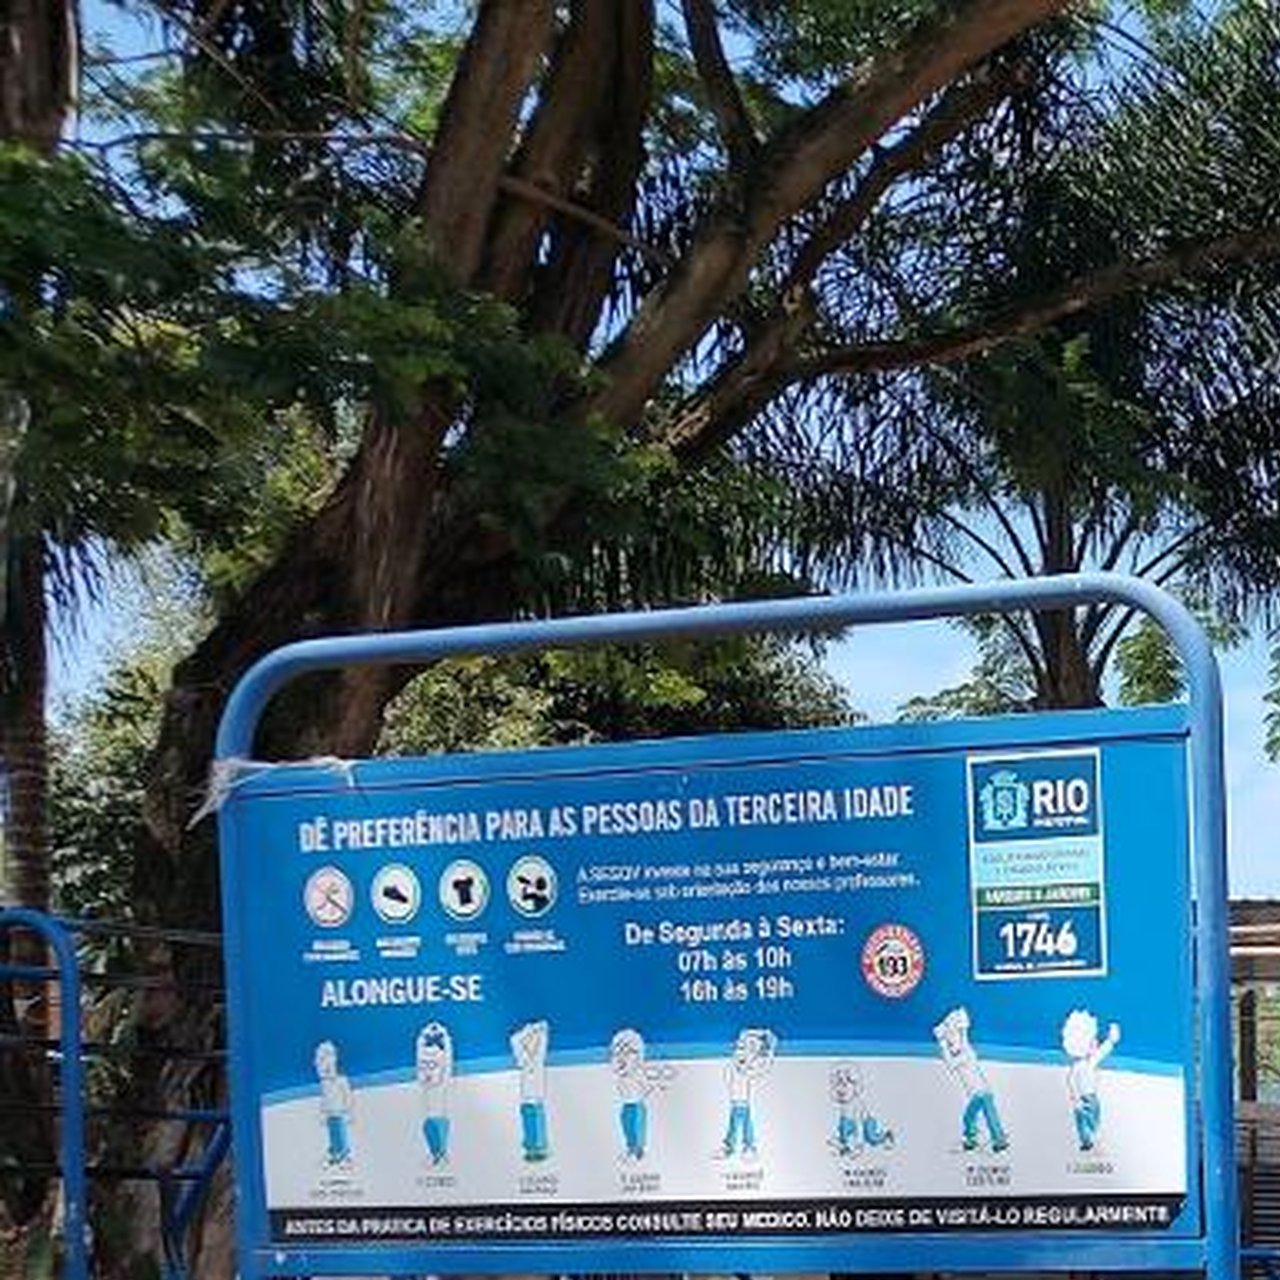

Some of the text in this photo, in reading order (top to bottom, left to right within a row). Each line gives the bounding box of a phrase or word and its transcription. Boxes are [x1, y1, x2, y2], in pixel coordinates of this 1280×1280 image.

[1032, 779, 1089, 815] RIO
[300, 785, 914, 852] DÊ PREFERÊNCIA PARA AS PESSOAS DA TERCEIRA IDADE
[816, 856, 826, 870] e
[625, 915, 844, 947] De Segunda à Sexta:
[1000, 920, 1078, 958] 1746
[678, 947, 792, 973] 07h às 10h
[321, 974, 485, 1007] ALONGUE-SE
[680, 977, 794, 1002] 16h às 19h
[285, 1217, 335, 1235] ANTES
[336, 1217, 360, 1234] DA
[430, 1216, 450, 1233] DE
[453, 1212, 548, 1232] EXERCÍCIOS
[551, 1210, 613, 1231] FÍSICOS
[616, 1212, 703, 1231] CONSULTE
[706, 1212, 737, 1230] SEU
[815, 1206, 851, 1228] NÃO
[855, 1208, 904, 1227] DEIXE
[909, 1208, 932, 1226] DE
[936, 1205, 1021, 1225] VISITÁ-LO
[1023, 1205, 1170, 1225] REGULARMENTE
